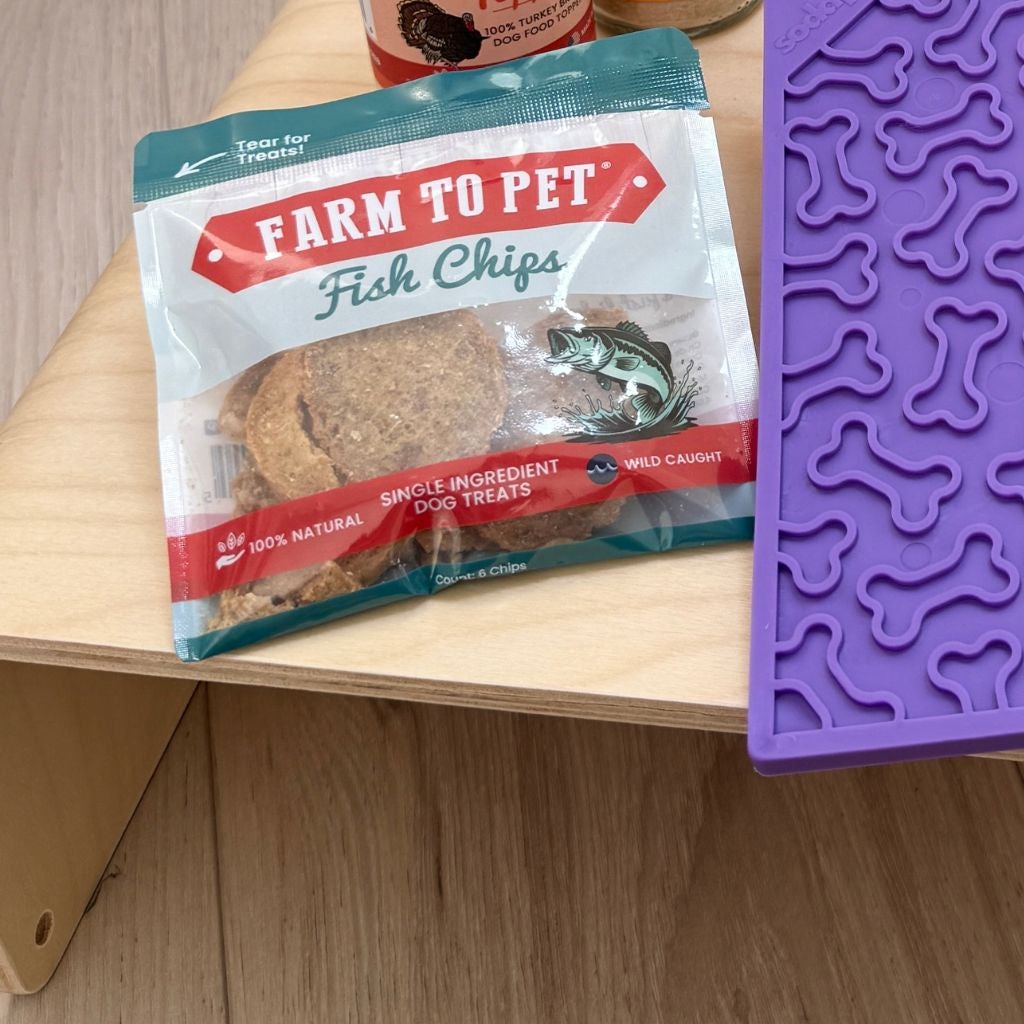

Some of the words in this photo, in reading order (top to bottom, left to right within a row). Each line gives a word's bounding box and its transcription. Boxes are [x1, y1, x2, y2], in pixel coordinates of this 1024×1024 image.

[485, 21, 516, 36] 100%
[519, 2, 559, 26] TURKEY
[494, 33, 521, 47] DOG
[525, 18, 555, 38] FOOD
[235, 137, 279, 152] Tear
[284, 134, 312, 146] for
[236, 144, 304, 164] Treats!
[255, 189, 407, 262] FARM
[419, 173, 485, 224] TO
[314, 253, 421, 321] Fish
[432, 236, 568, 293] Chips
[624, 455, 661, 471] WILD
[665, 451, 723, 466] CAUGHT
[380, 478, 445, 508] SINGLE
[450, 458, 560, 493] INGREDIENT
[414, 495, 457, 515] DOG
[462, 481, 532, 509] TREATS
[250, 534, 288, 554] 100%
[291, 512, 365, 543] NATURAL
[478, 568, 487, 578] 6
[489, 562, 527, 575] Chips
